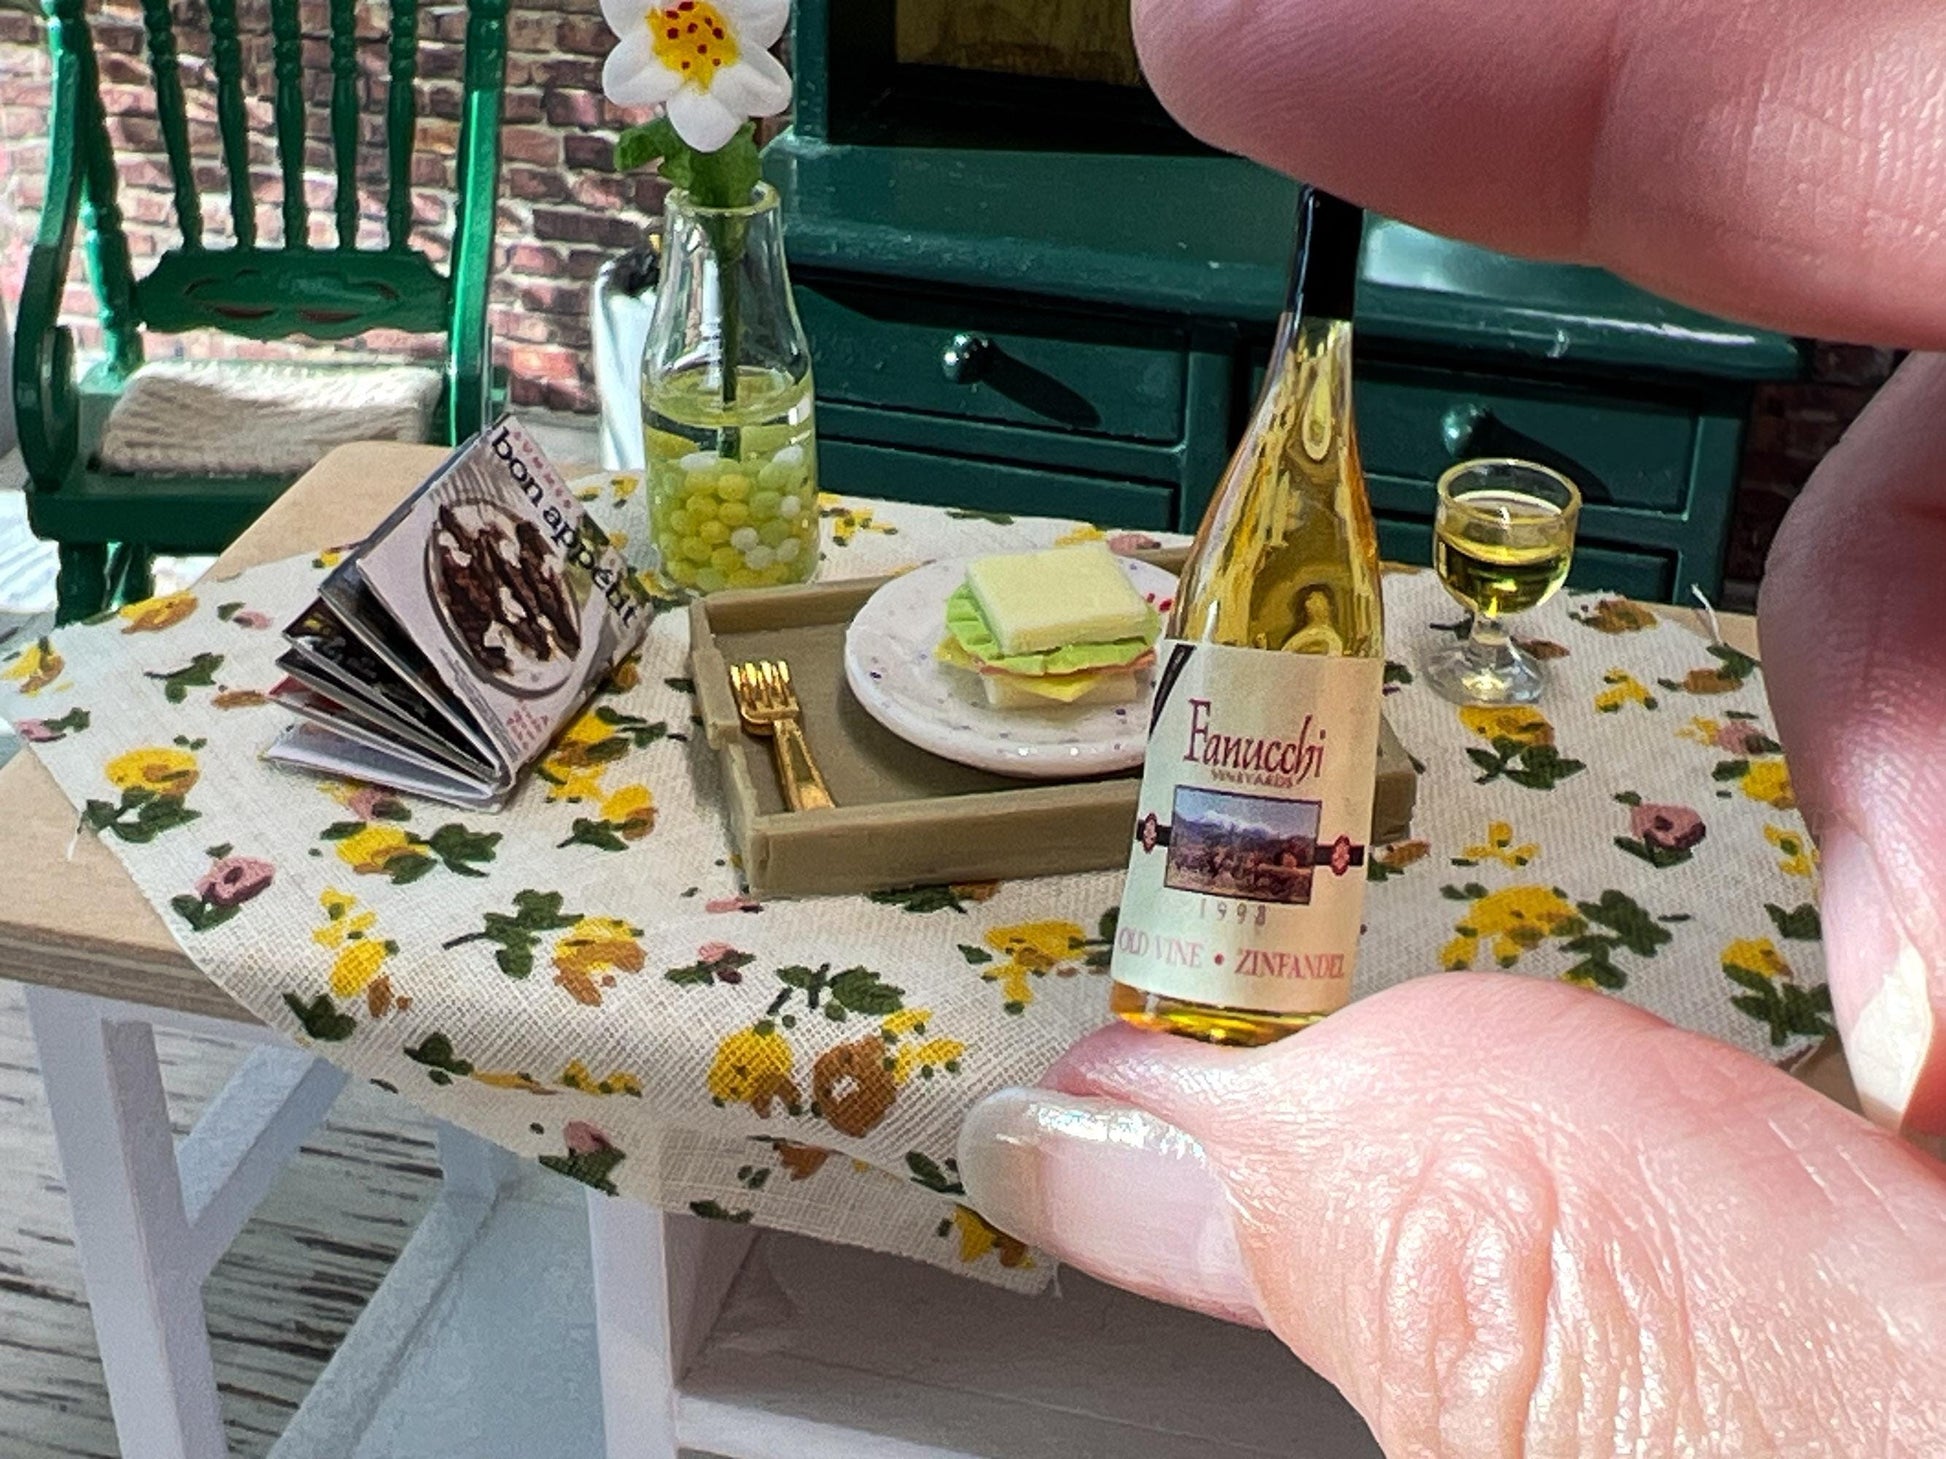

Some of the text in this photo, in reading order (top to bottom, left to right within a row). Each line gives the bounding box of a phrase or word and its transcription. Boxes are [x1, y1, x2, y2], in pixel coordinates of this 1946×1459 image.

[492, 427, 544, 508] bon
[1184, 699, 1326, 783] Fanucchi
[1200, 899, 1266, 926] 1998
[1119, 927, 1344, 979] OLD VINE ZINFANDEL
